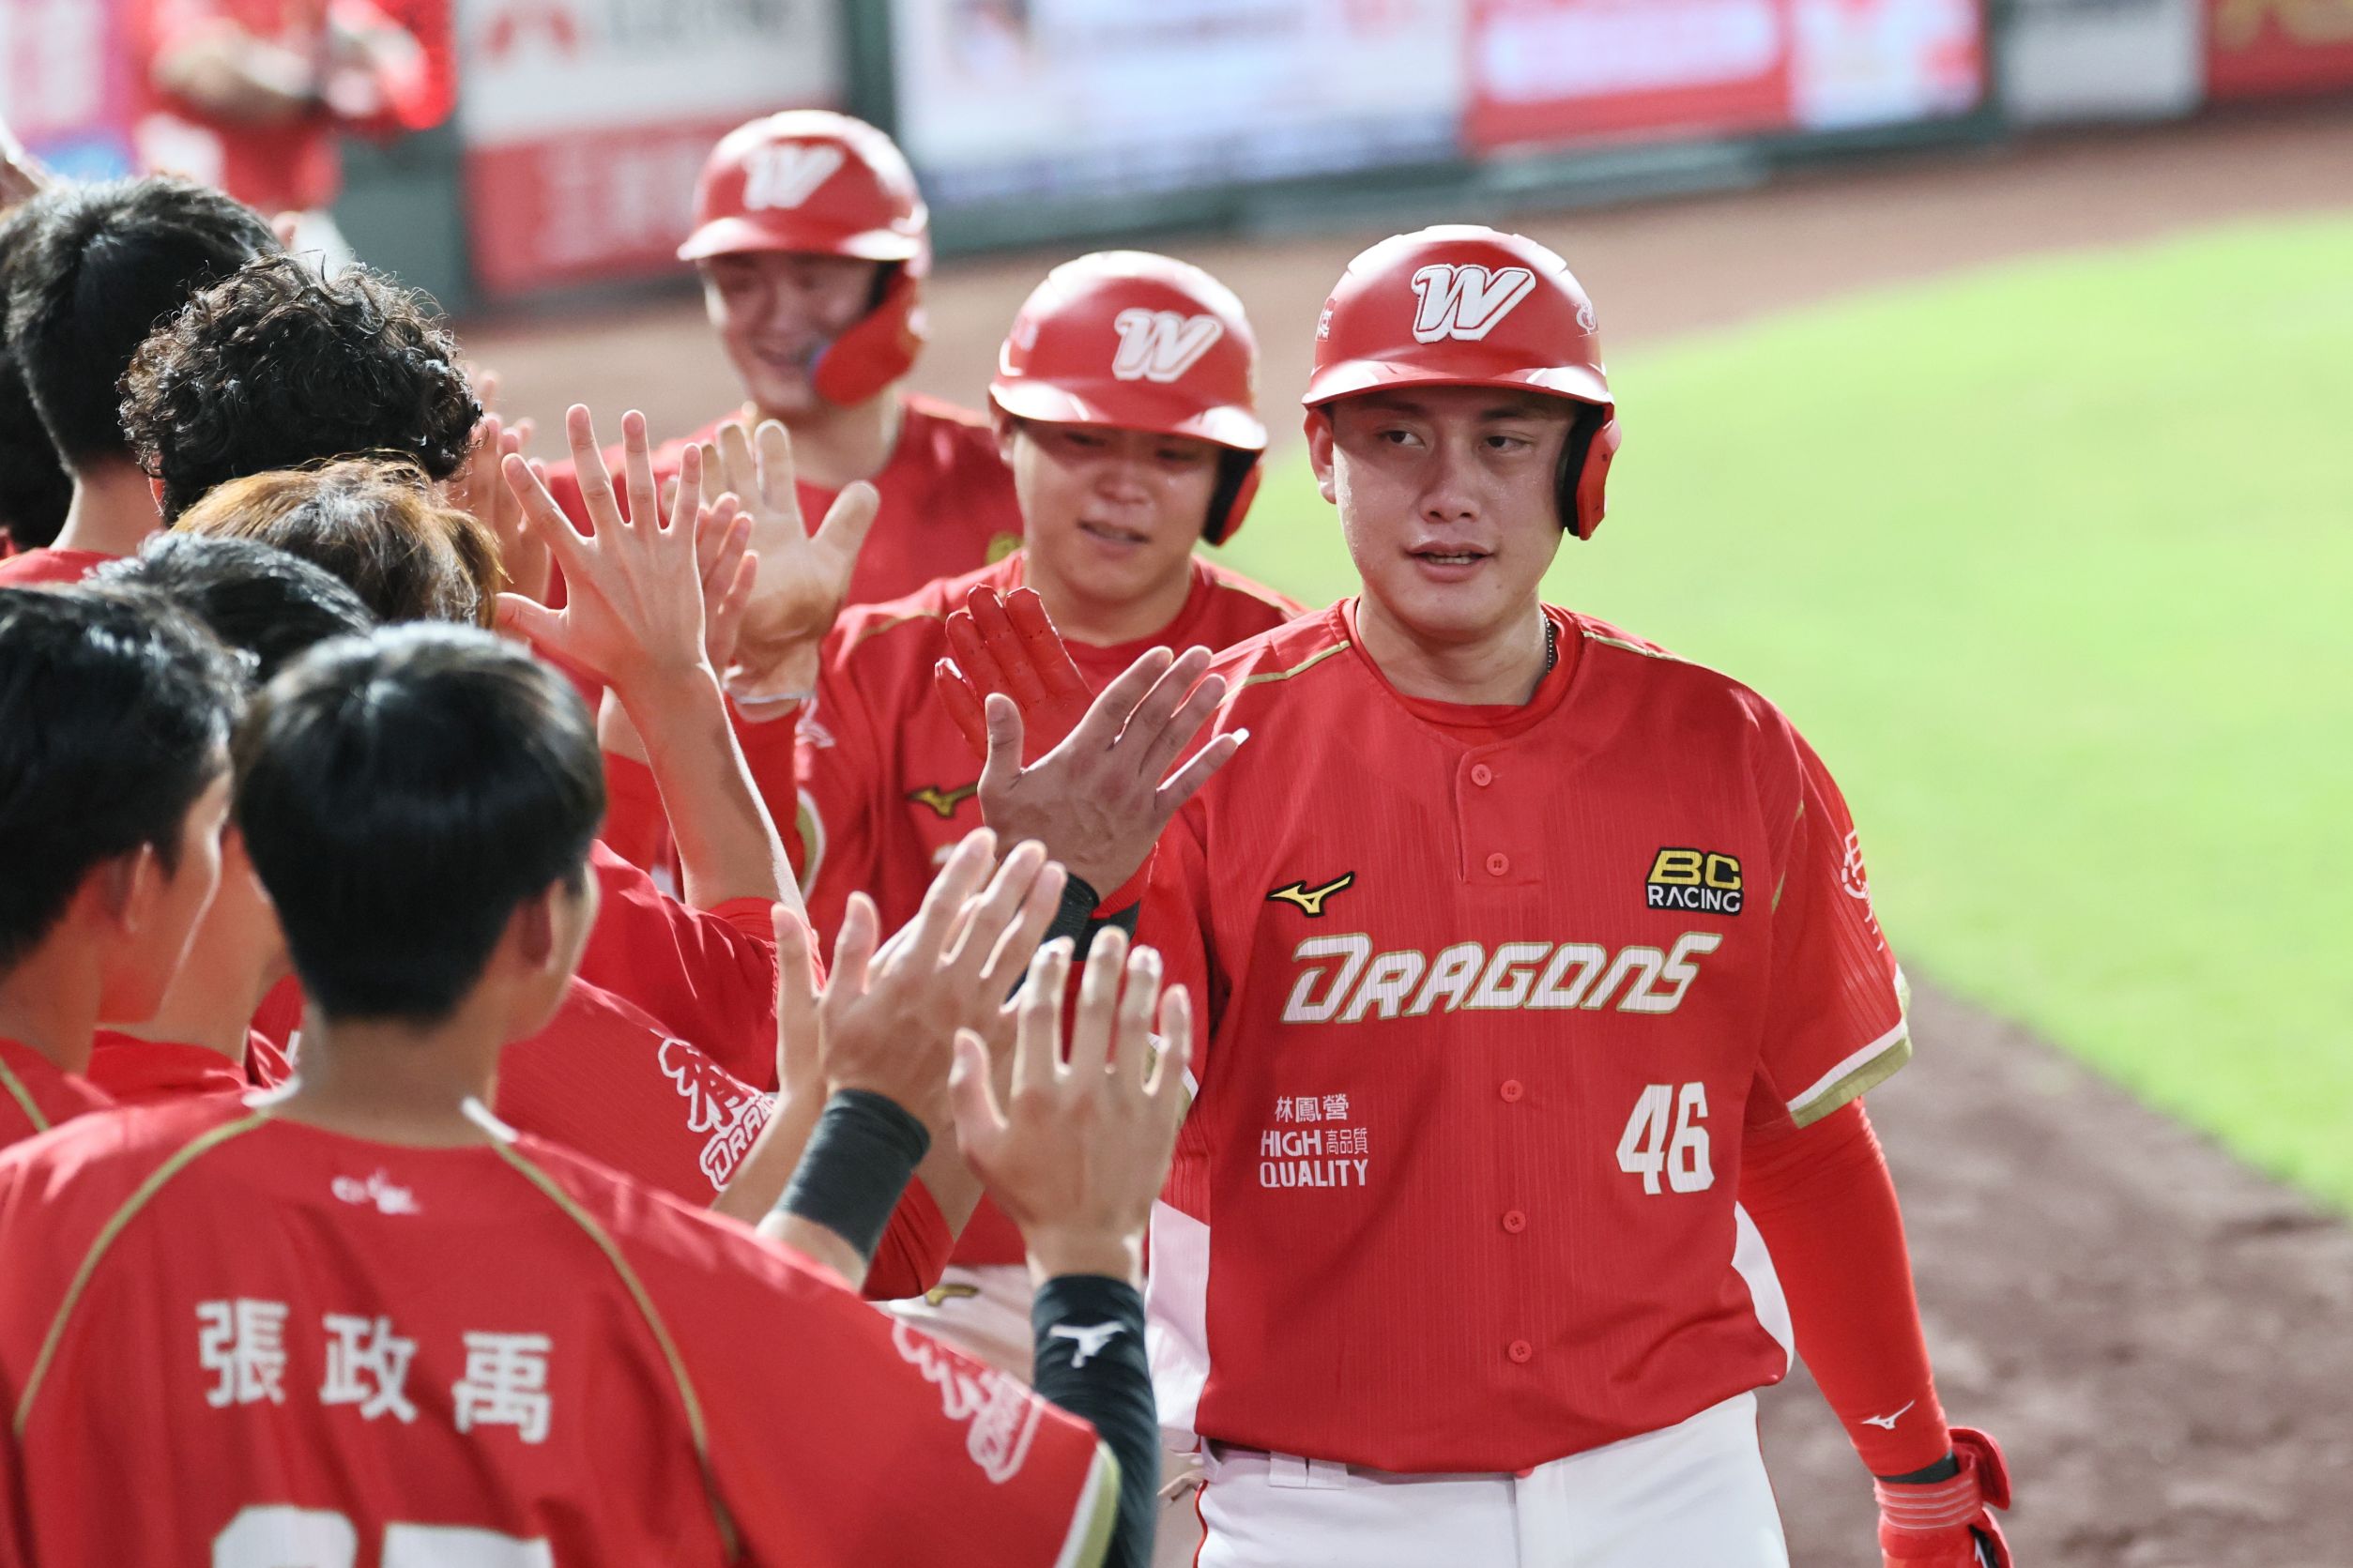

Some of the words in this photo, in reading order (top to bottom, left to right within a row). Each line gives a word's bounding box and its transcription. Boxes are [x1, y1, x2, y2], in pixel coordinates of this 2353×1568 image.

[743, 145, 842, 210] W
[1411, 263, 1536, 343] W
[1112, 308, 1223, 384] W
[1648, 850, 1742, 890] BC
[1647, 885, 1741, 913] RACING
[1275, 1093, 1349, 1123] 林鳳營
[1261, 1129, 1322, 1157] HIGH
[1325, 1127, 1368, 1155] 高品質
[1615, 1082, 1716, 1195] 46
[1260, 1159, 1368, 1188] QUALITY
[195, 1298, 554, 1445] 張政禹
